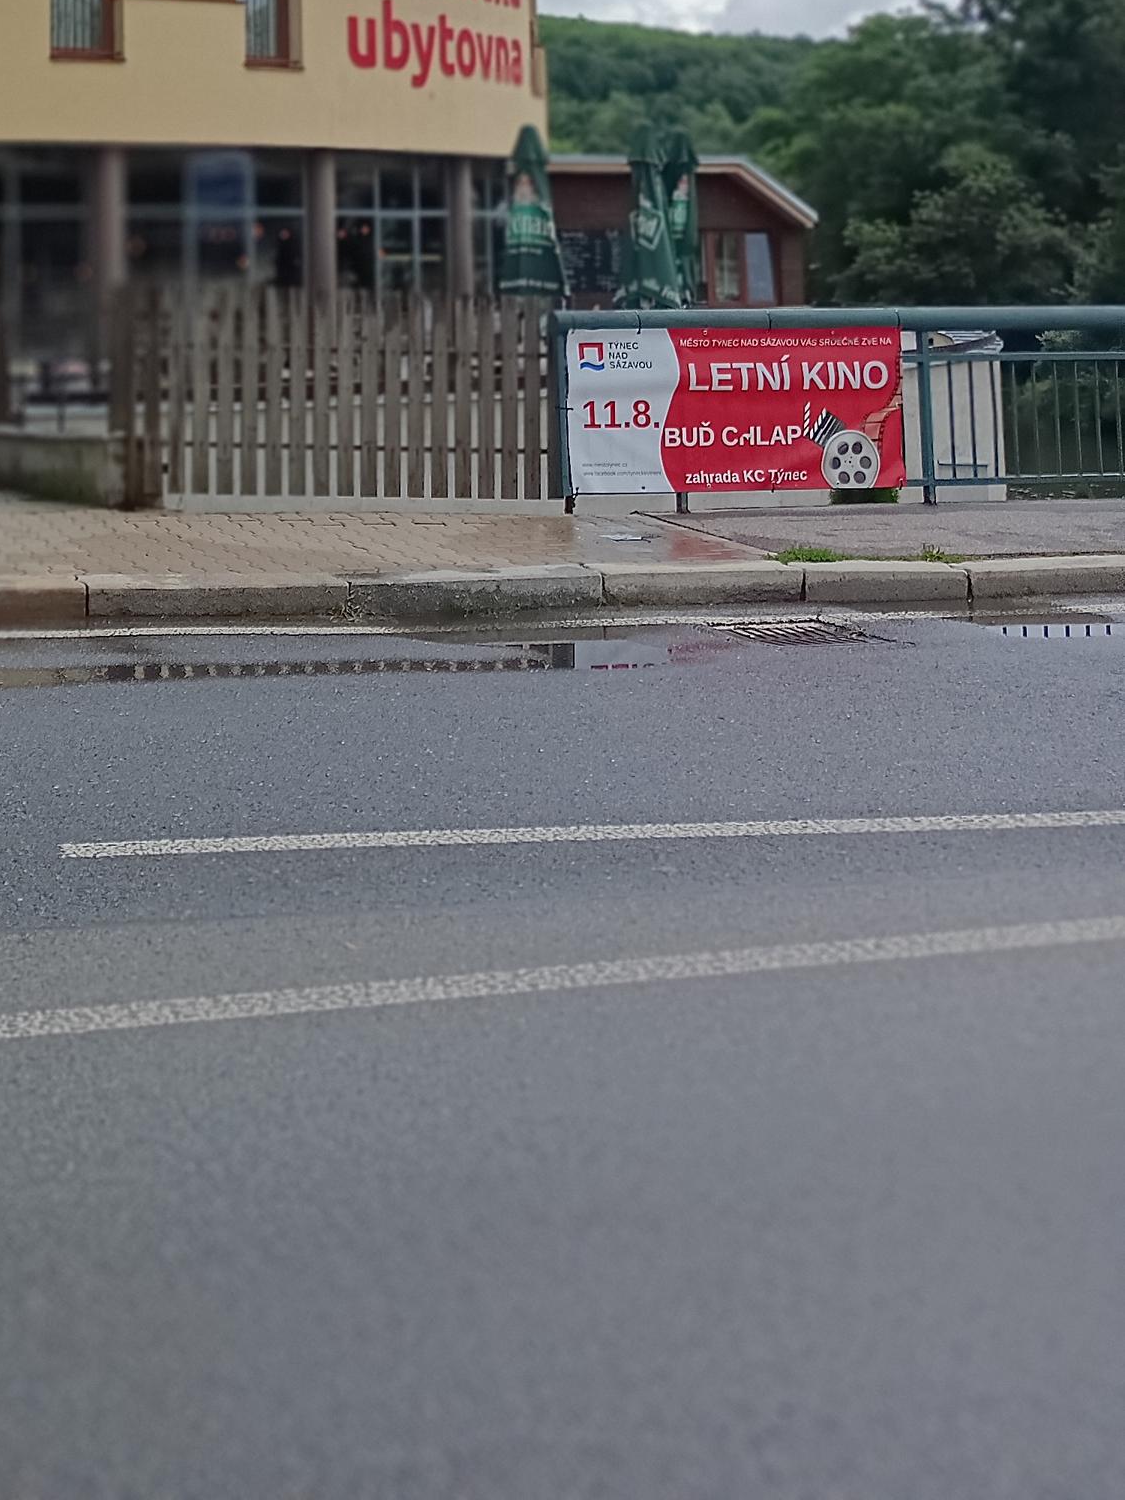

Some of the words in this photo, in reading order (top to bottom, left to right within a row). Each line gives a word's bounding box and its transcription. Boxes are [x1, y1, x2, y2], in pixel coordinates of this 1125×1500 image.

[740, 336, 759, 347] NAD
[760, 336, 799, 347] SÁZAVOU
[800, 337, 817, 347] VÁS
[861, 337, 878, 346] ZVE
[879, 337, 892, 345] NA
[608, 351, 628, 360] NAD
[609, 359, 653, 369] SÁZAVOU
[687, 354, 791, 392] LETNÍ
[801, 361, 889, 391] KINO
[582, 400, 660, 429] 11.8.
[664, 421, 715, 447] BUĎ
[685, 471, 740, 484] zahrada
[743, 469, 765, 483] KC
[768, 468, 808, 483] Týnec
